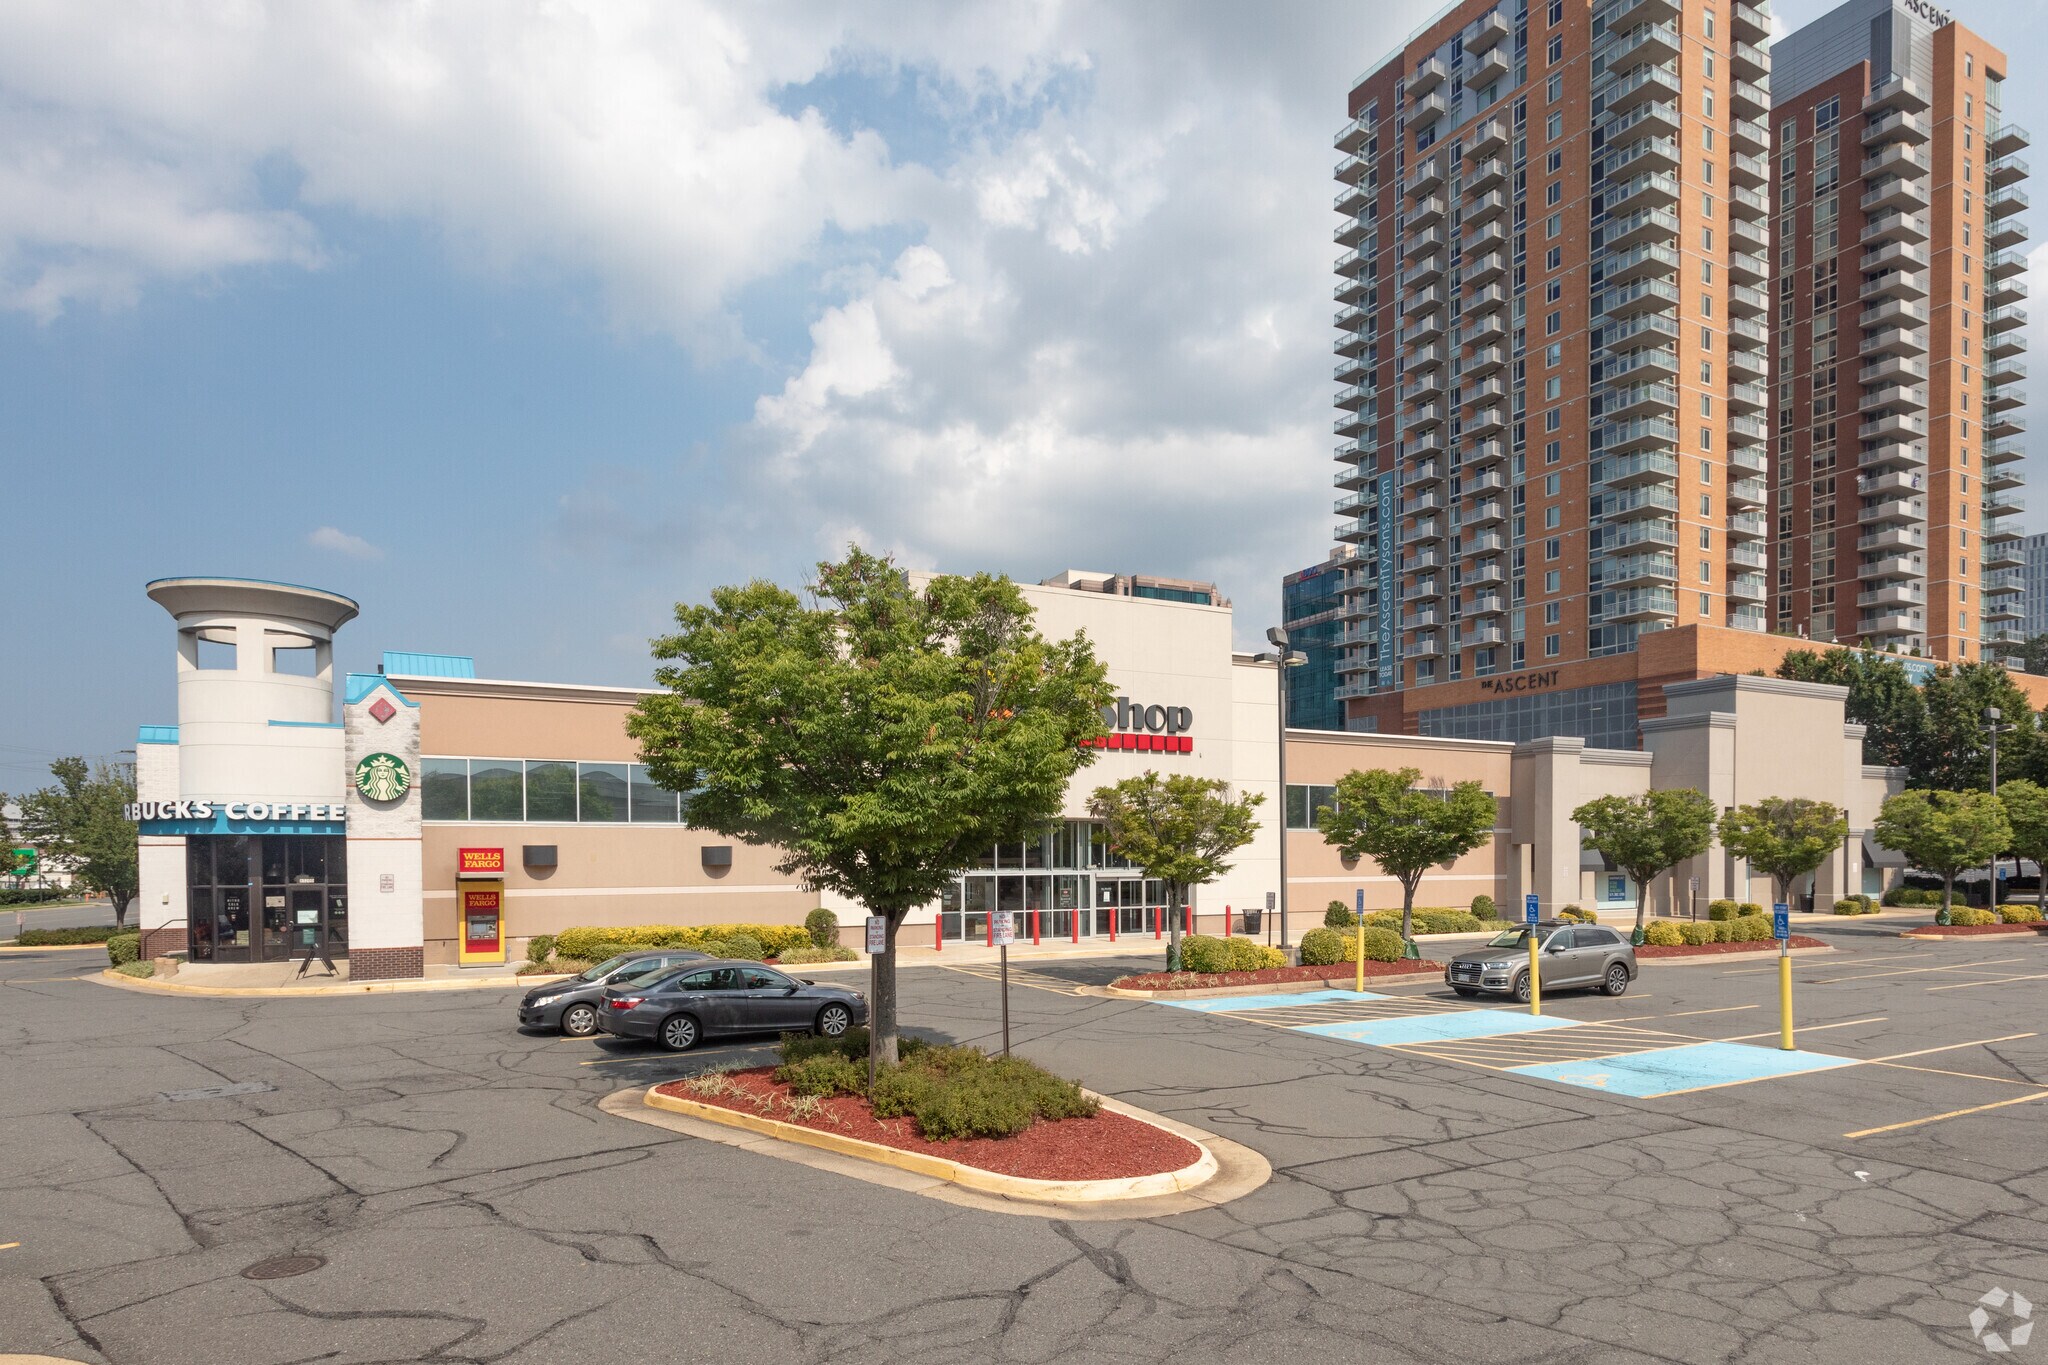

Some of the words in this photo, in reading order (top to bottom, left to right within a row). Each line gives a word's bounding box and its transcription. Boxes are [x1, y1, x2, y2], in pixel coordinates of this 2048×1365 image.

[1380, 479, 1393, 661] TheAscentTysons.com
[1494, 670, 1559, 694] ASCENT
[224, 801, 346, 821] COFFEE
